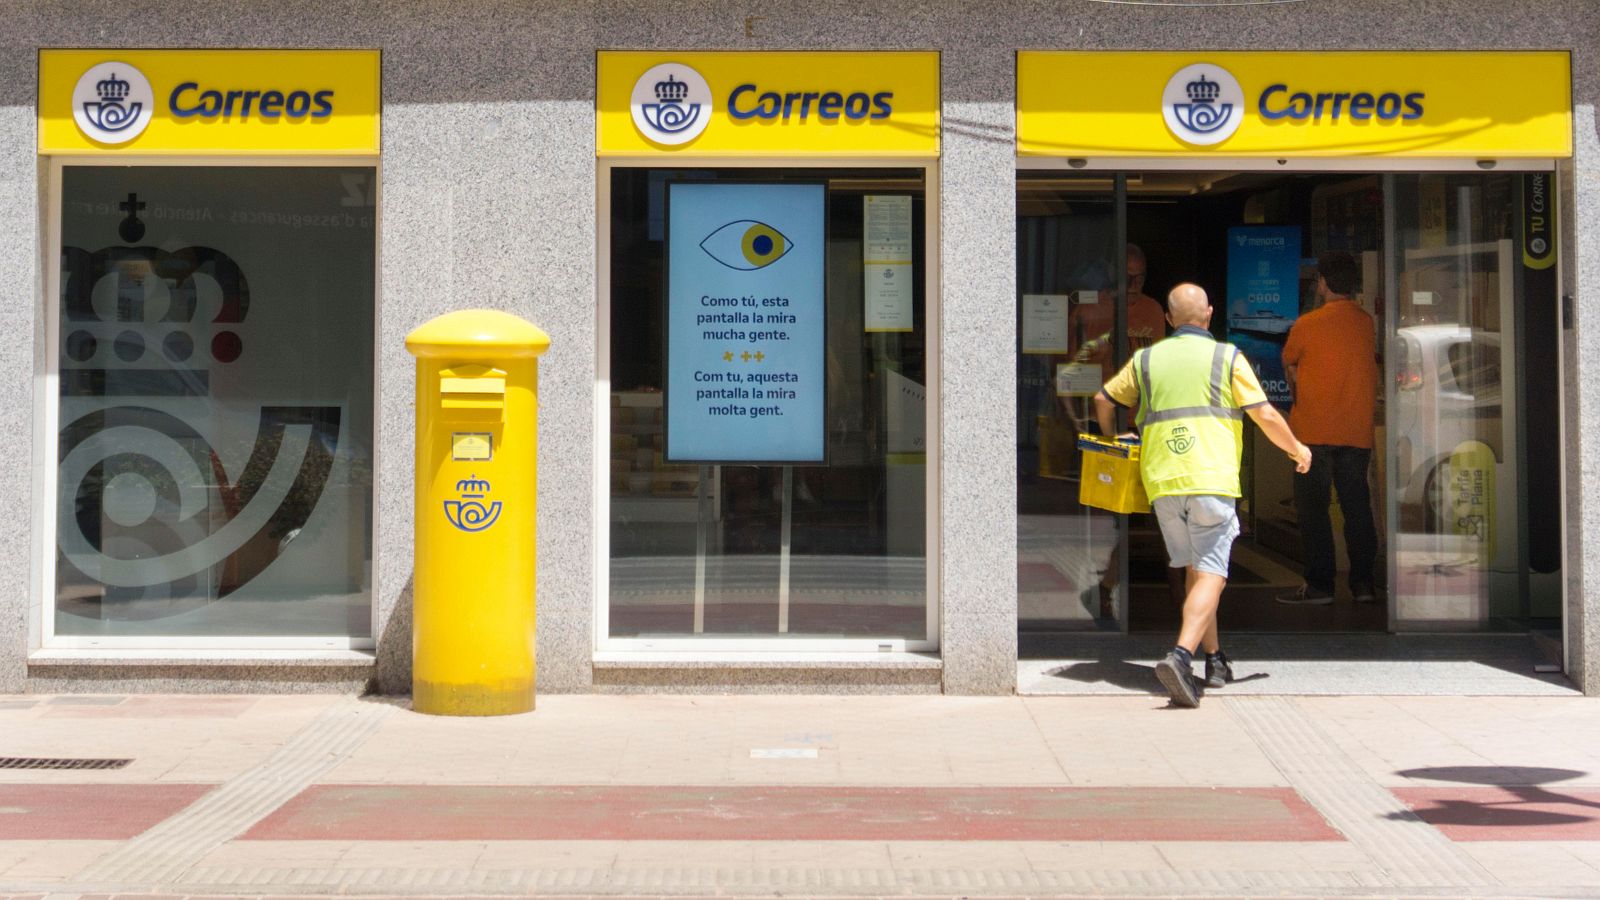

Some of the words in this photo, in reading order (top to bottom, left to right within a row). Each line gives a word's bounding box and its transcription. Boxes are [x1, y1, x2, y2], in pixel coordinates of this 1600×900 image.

[169, 82, 334, 119] Correos
[728, 84, 893, 120] Correos
[1259, 84, 1425, 120] Correos
[1531, 172, 1545, 213] CORRE
[1531, 216, 1545, 233] TU
[1247, 236, 1285, 247] menorca
[701, 295, 739, 307] Como
[741, 294, 759, 309] tú,
[762, 296, 790, 307] esta
[696, 311, 750, 326] pantalla
[752, 312, 764, 324] la
[767, 312, 797, 324] mira
[703, 328, 746, 340] mucha
[748, 329, 790, 343] gente.
[694, 370, 724, 383] Com
[726, 371, 744, 384] tu,
[746, 371, 799, 385] aquesta
[696, 387, 749, 401] pantalla
[752, 387, 764, 399] la
[766, 387, 796, 399] mira
[708, 404, 747, 416] molta
[749, 405, 784, 419] gent.
[1456, 470, 1469, 507] Tarifa
[1471, 470, 1483, 505] Plana
